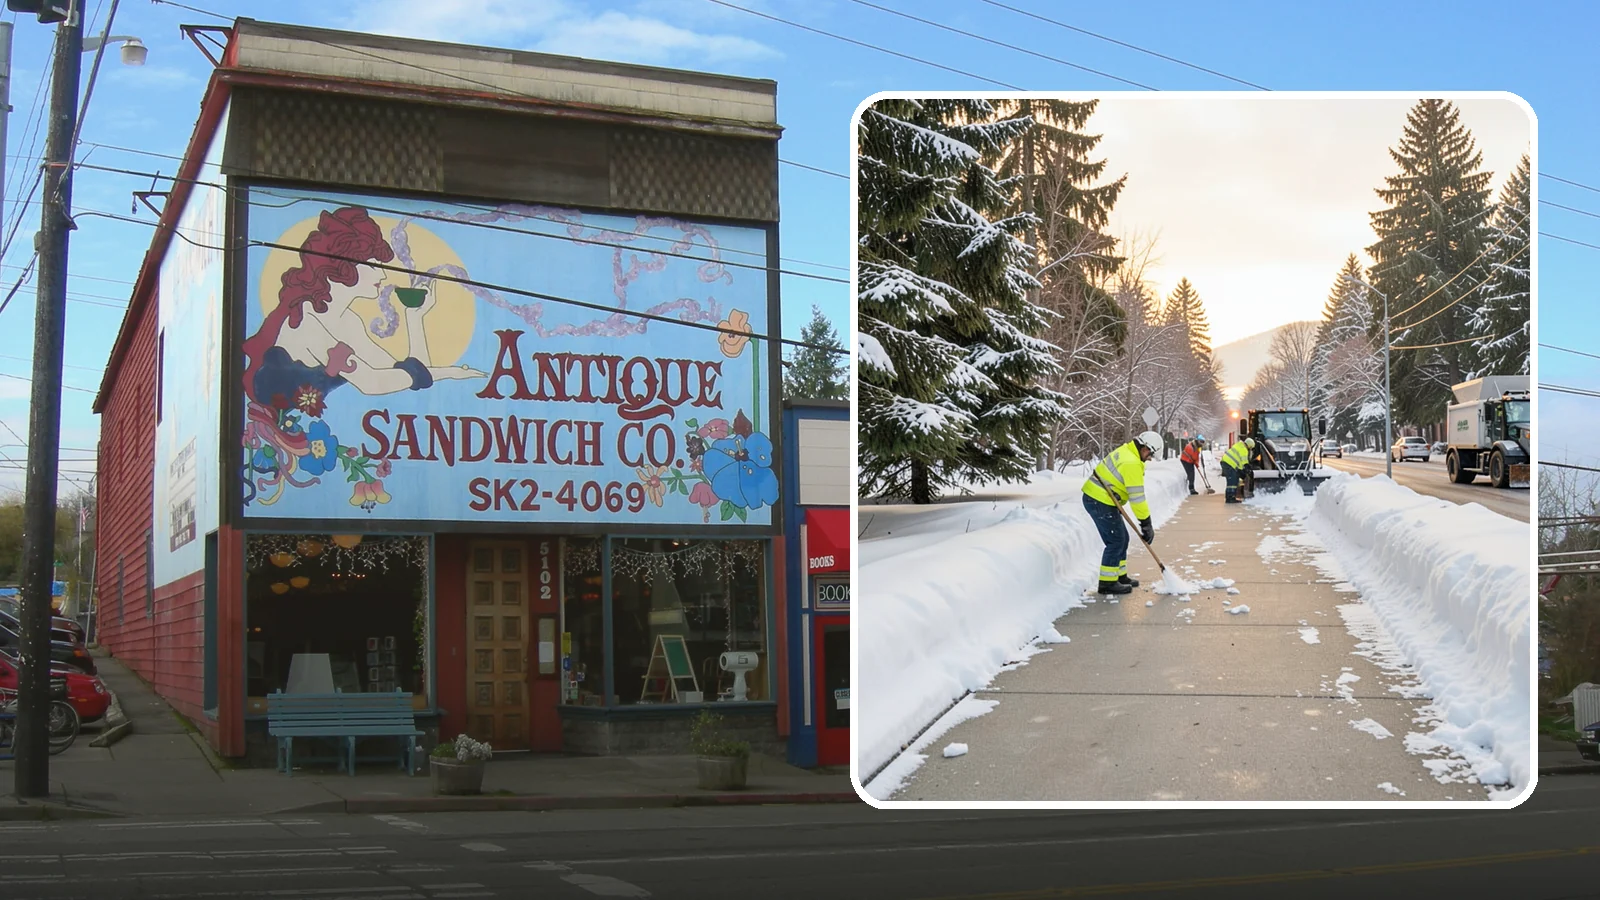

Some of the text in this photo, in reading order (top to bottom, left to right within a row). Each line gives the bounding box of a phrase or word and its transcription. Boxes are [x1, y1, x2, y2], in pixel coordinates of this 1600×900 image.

[475, 329, 724, 421] ANTIQUE
[361, 408, 685, 469] SANDWICH CO.
[468, 478, 645, 513] SK2-4069
[539, 542, 551, 599] 5102
[809, 555, 835, 569] BOOKS
